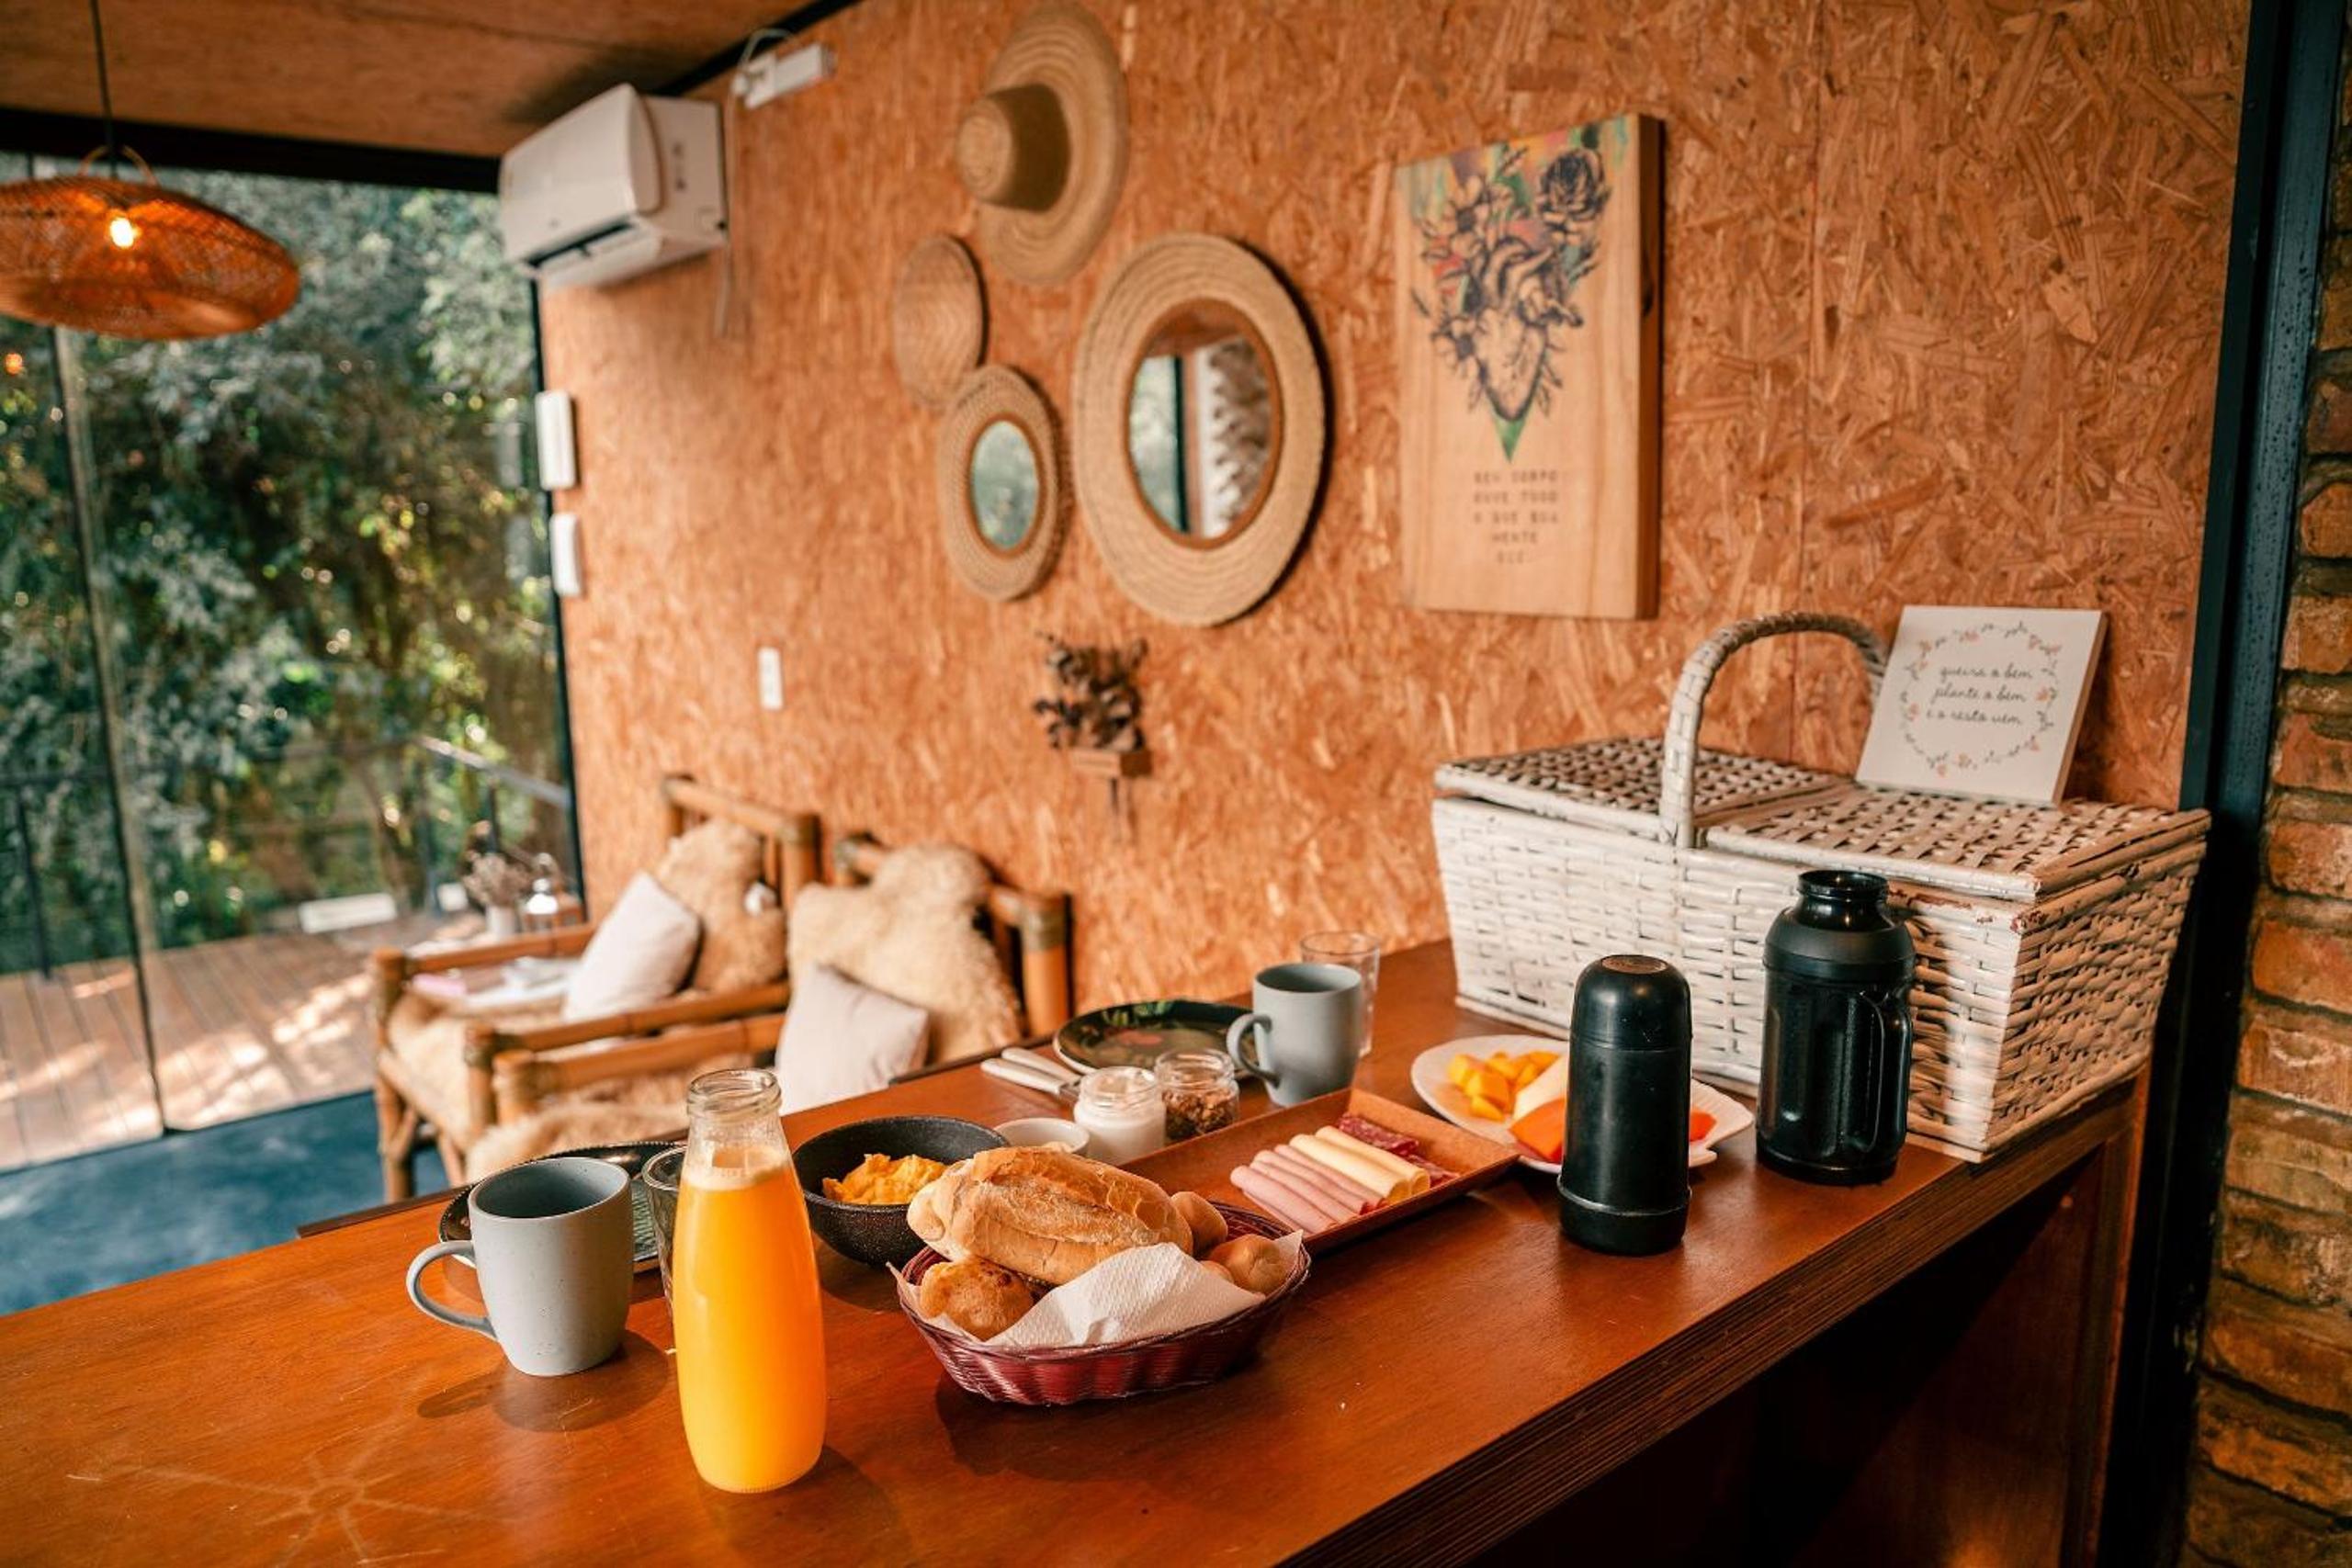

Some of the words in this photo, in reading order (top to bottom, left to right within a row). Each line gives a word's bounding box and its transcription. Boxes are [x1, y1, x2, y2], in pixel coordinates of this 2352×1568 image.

[2005, 661, 2033, 679] bem
[1930, 682, 1979, 705] plante
[1996, 684, 2027, 703] bem
[1951, 709, 1987, 722] resto
